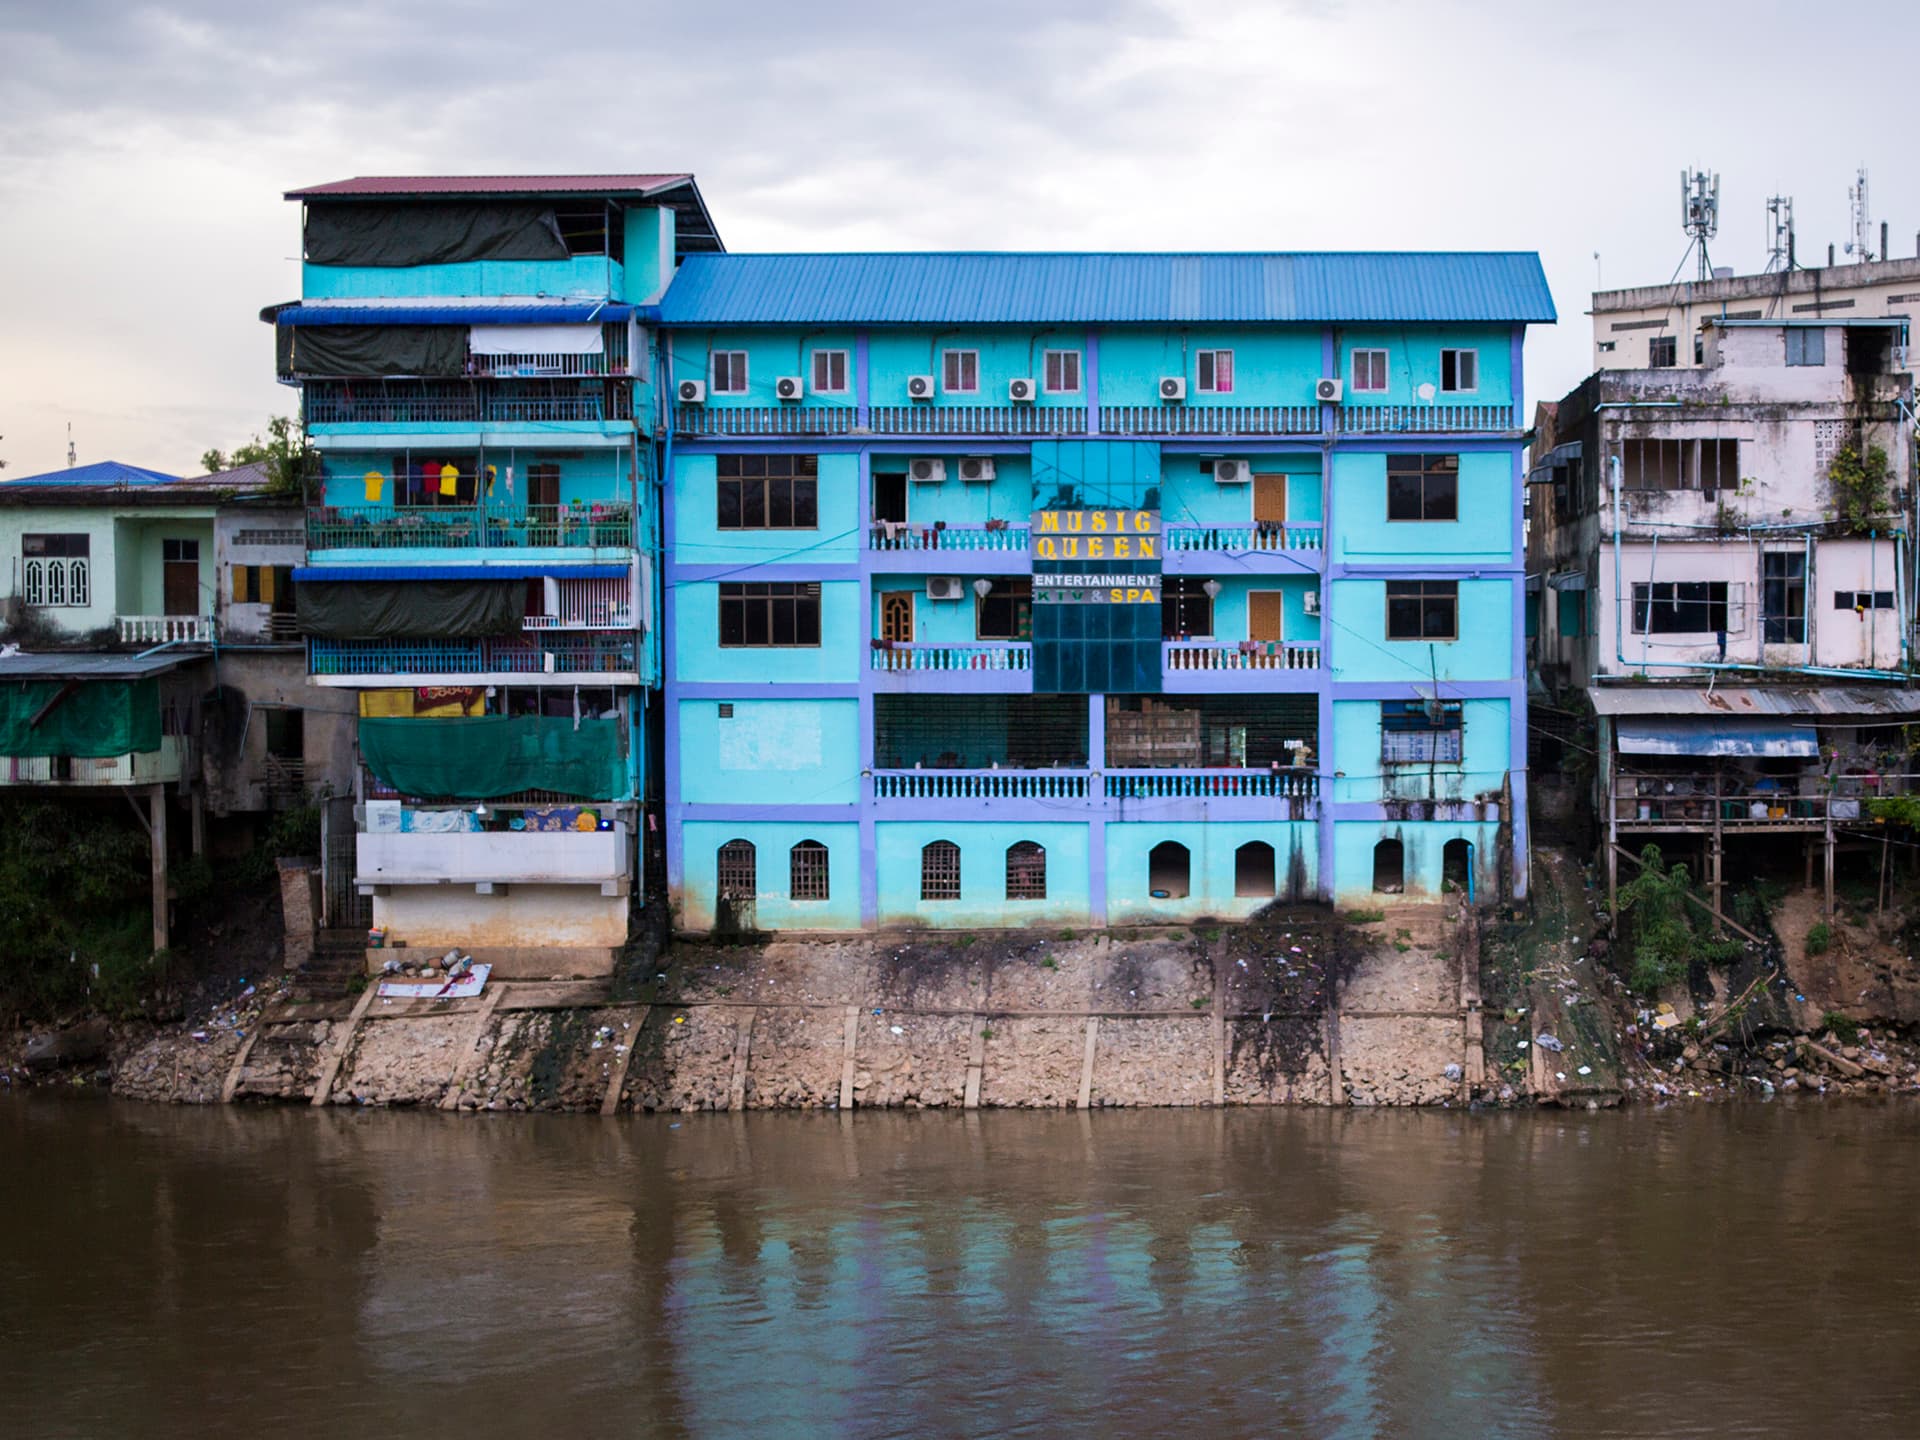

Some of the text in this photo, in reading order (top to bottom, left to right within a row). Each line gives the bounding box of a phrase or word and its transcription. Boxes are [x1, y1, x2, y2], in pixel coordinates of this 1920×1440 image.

[1040, 511, 1151, 532] MUSIC
[1037, 537, 1155, 560] QUEEN
[1035, 575, 1156, 586] ENTERTAINMENT
[1037, 588, 1155, 604] KTV & SPA
